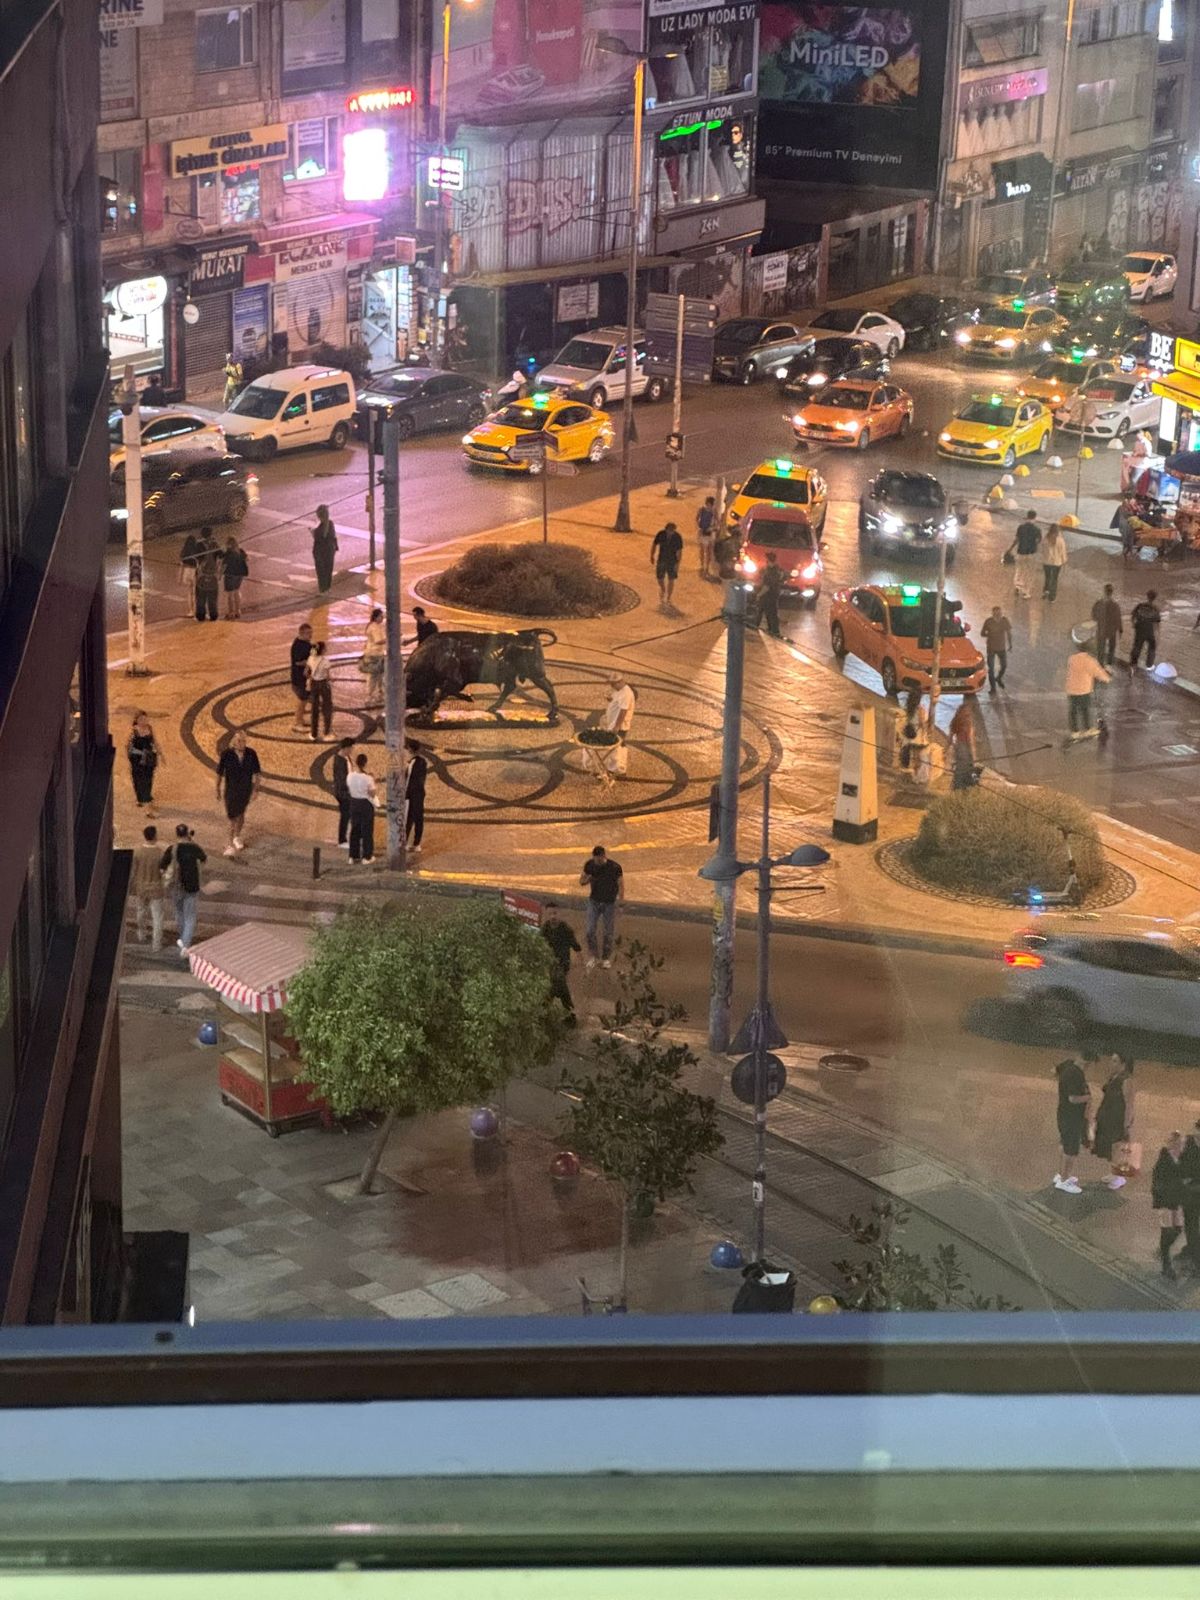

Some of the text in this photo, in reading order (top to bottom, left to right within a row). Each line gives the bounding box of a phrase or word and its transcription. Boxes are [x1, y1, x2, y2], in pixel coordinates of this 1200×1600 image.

[678, 12, 705, 30] LADY
[708, 7, 737, 25] MODA
[789, 41, 889, 69] MiniLED
[706, 105, 733, 120] MODA
[785, 146, 832, 159] Premium
[835, 150, 849, 161] TV
[851, 150, 902, 165] Deneyimi
